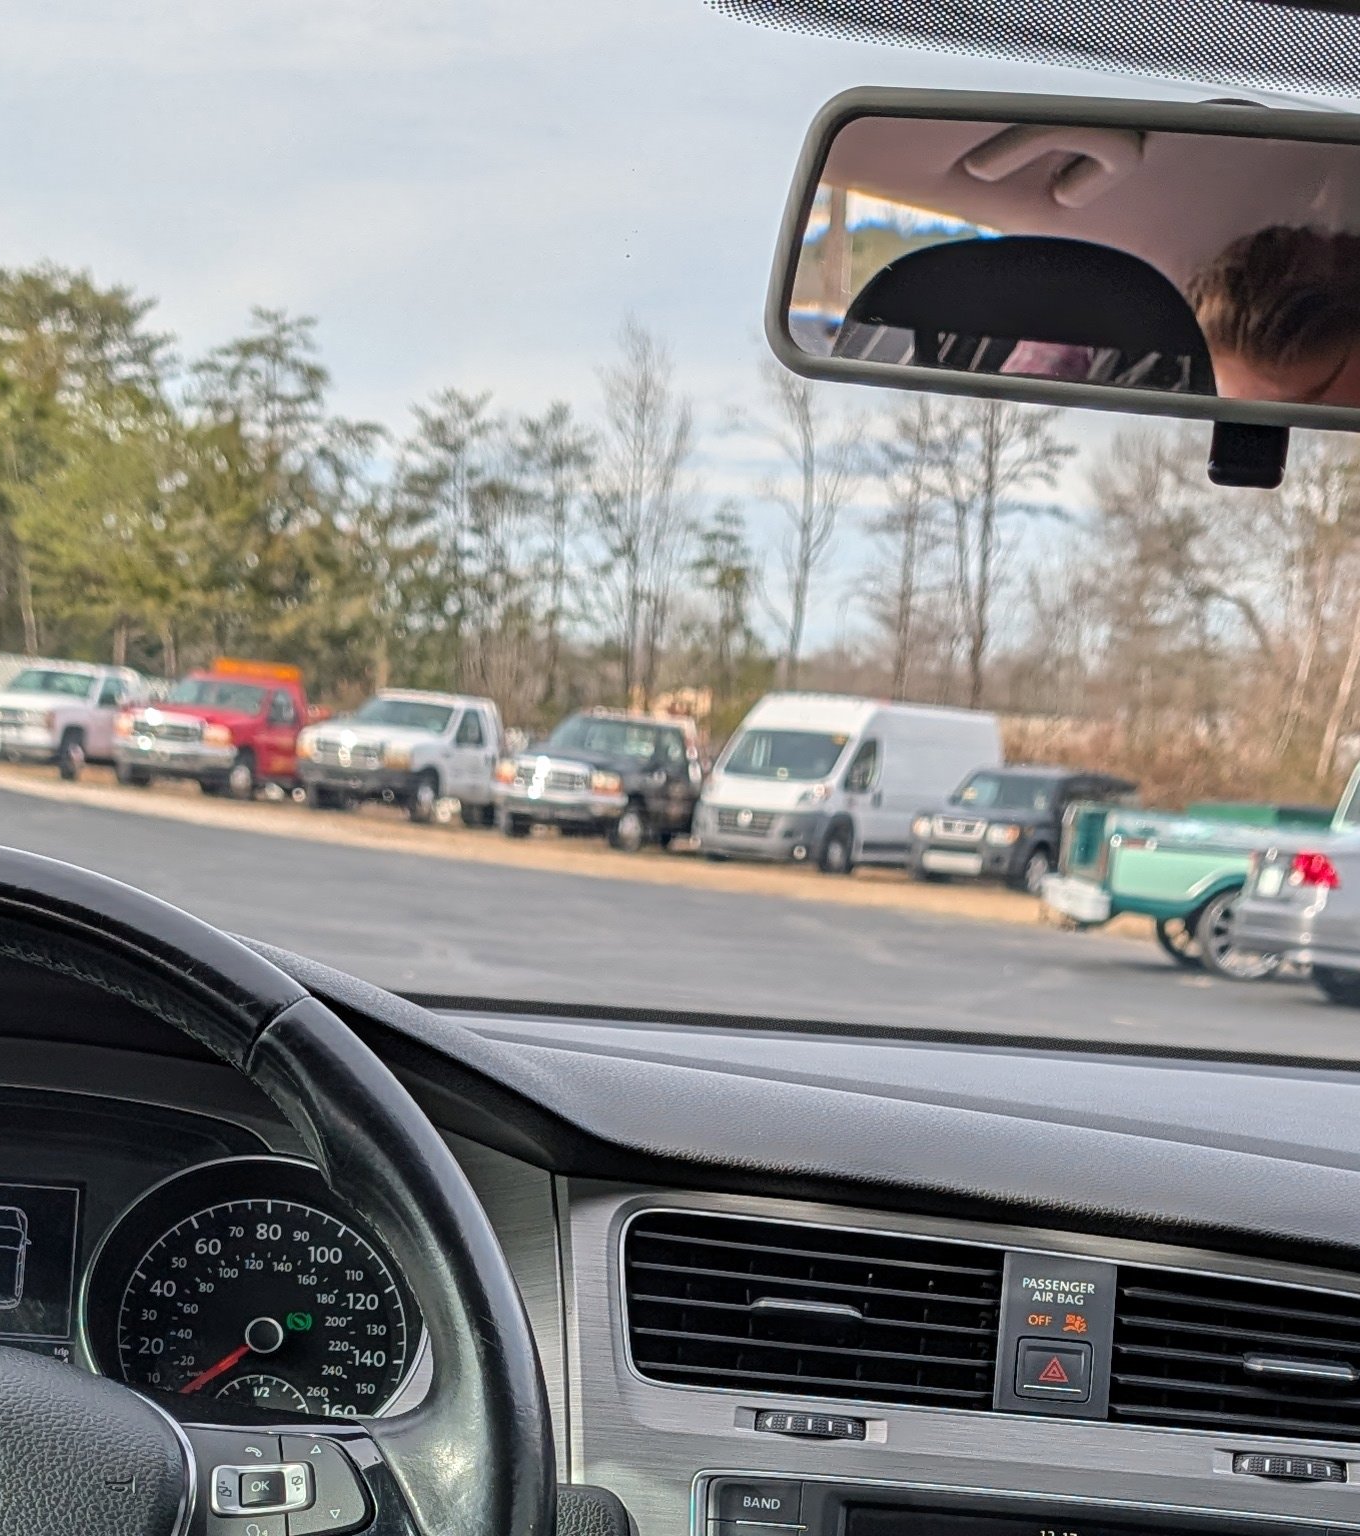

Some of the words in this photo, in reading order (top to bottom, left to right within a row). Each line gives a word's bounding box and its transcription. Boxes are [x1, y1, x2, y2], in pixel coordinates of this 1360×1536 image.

[229, 1226, 244, 1238] 70
[256, 1224, 282, 1240] 80
[292, 1231, 310, 1242] 90
[195, 1238, 221, 1255] 60
[307, 1246, 342, 1264] 100
[171, 1257, 187, 1269] 50
[245, 1259, 263, 1270] 120
[273, 1261, 292, 1272] 140
[219, 1267, 239, 1279] 100
[345, 1270, 363, 1281] 110
[297, 1275, 317, 1286] 160
[1022, 1277, 1095, 1295] PASSENGER
[149, 1280, 176, 1297] 40
[199, 1282, 214, 1293] 80
[316, 1293, 336, 1304] 180
[346, 1293, 379, 1310] 120
[1032, 1291, 1053, 1303] AIR
[1057, 1293, 1084, 1306] BAG
[183, 1303, 198, 1314] 60
[141, 1309, 157, 1321] 30
[1028, 1314, 1053, 1326] OFF
[324, 1316, 347, 1327] 200
[177, 1328, 193, 1339] 40
[366, 1324, 386, 1336] 130
[138, 1337, 164, 1354] 20
[328, 1341, 349, 1351] 220
[180, 1355, 195, 1366] 20
[352, 1350, 386, 1367] 140
[321, 1365, 343, 1376] 240
[147, 1372, 160, 1383] 10
[253, 1387, 270, 1398] 1/2
[306, 1386, 328, 1397] 260
[356, 1383, 375, 1394] 150
[322, 1404, 357, 1416] 160
[251, 1480, 270, 1492] OK
[743, 1496, 781, 1510] BAND
